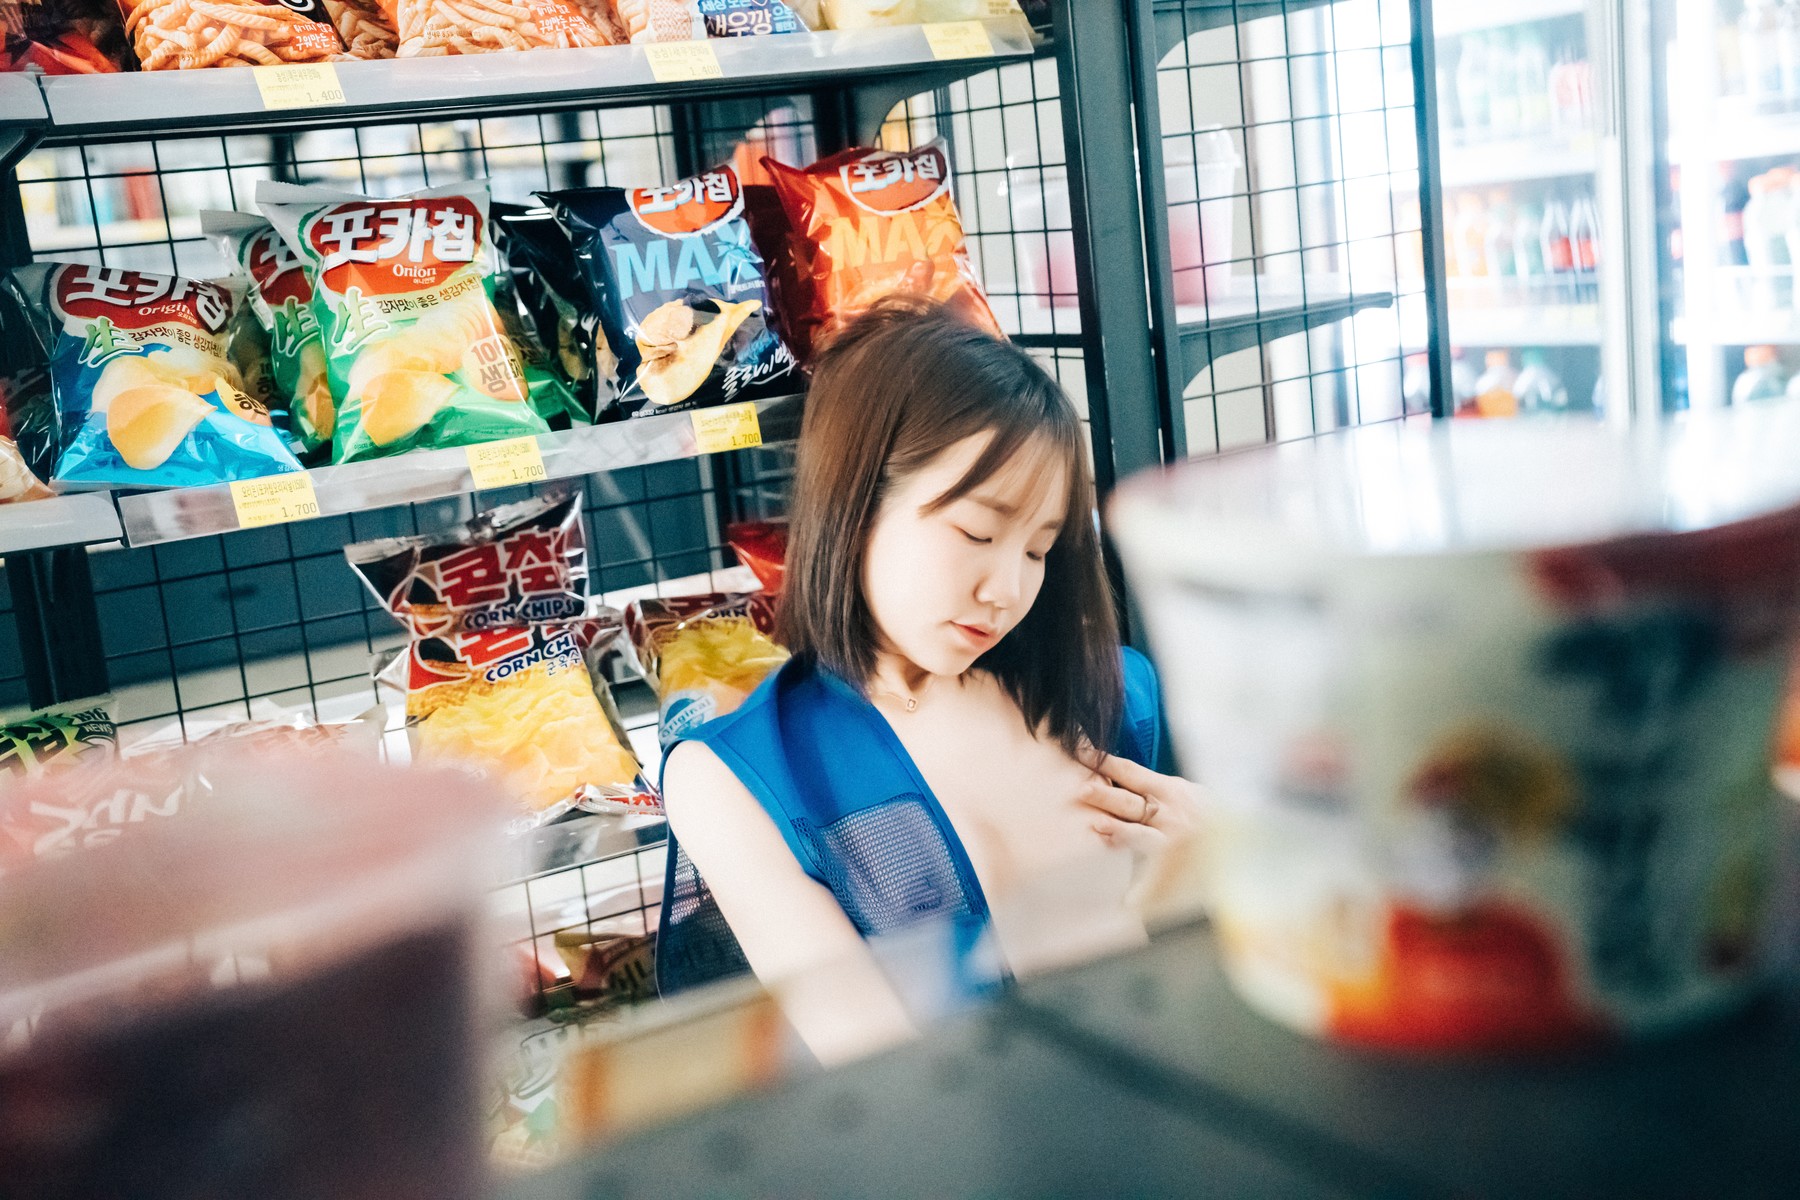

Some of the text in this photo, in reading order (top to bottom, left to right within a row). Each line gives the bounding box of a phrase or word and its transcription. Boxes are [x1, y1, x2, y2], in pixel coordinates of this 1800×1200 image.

[851, 153, 940, 193] 포카칩
[319, 206, 475, 273] 포카칩
[830, 193, 965, 273] MAX
[393, 264, 437, 277] Onion
[611, 217, 763, 299] MAX
[138, 302, 194, 317] Origin
[376, 298, 418, 314] 감자맛이
[417, 294, 439, 308] 좋은
[128, 326, 175, 342] 감자맛이
[176, 328, 192, 345] 좋은
[512, 465, 544, 480] 1,700
[282, 502, 317, 518] 1,700
[464, 599, 574, 629] CORN CHIPS
[485, 651, 542, 682] CORN
[83, 722, 114, 734] NEWS
[660, 696, 711, 739] Original
